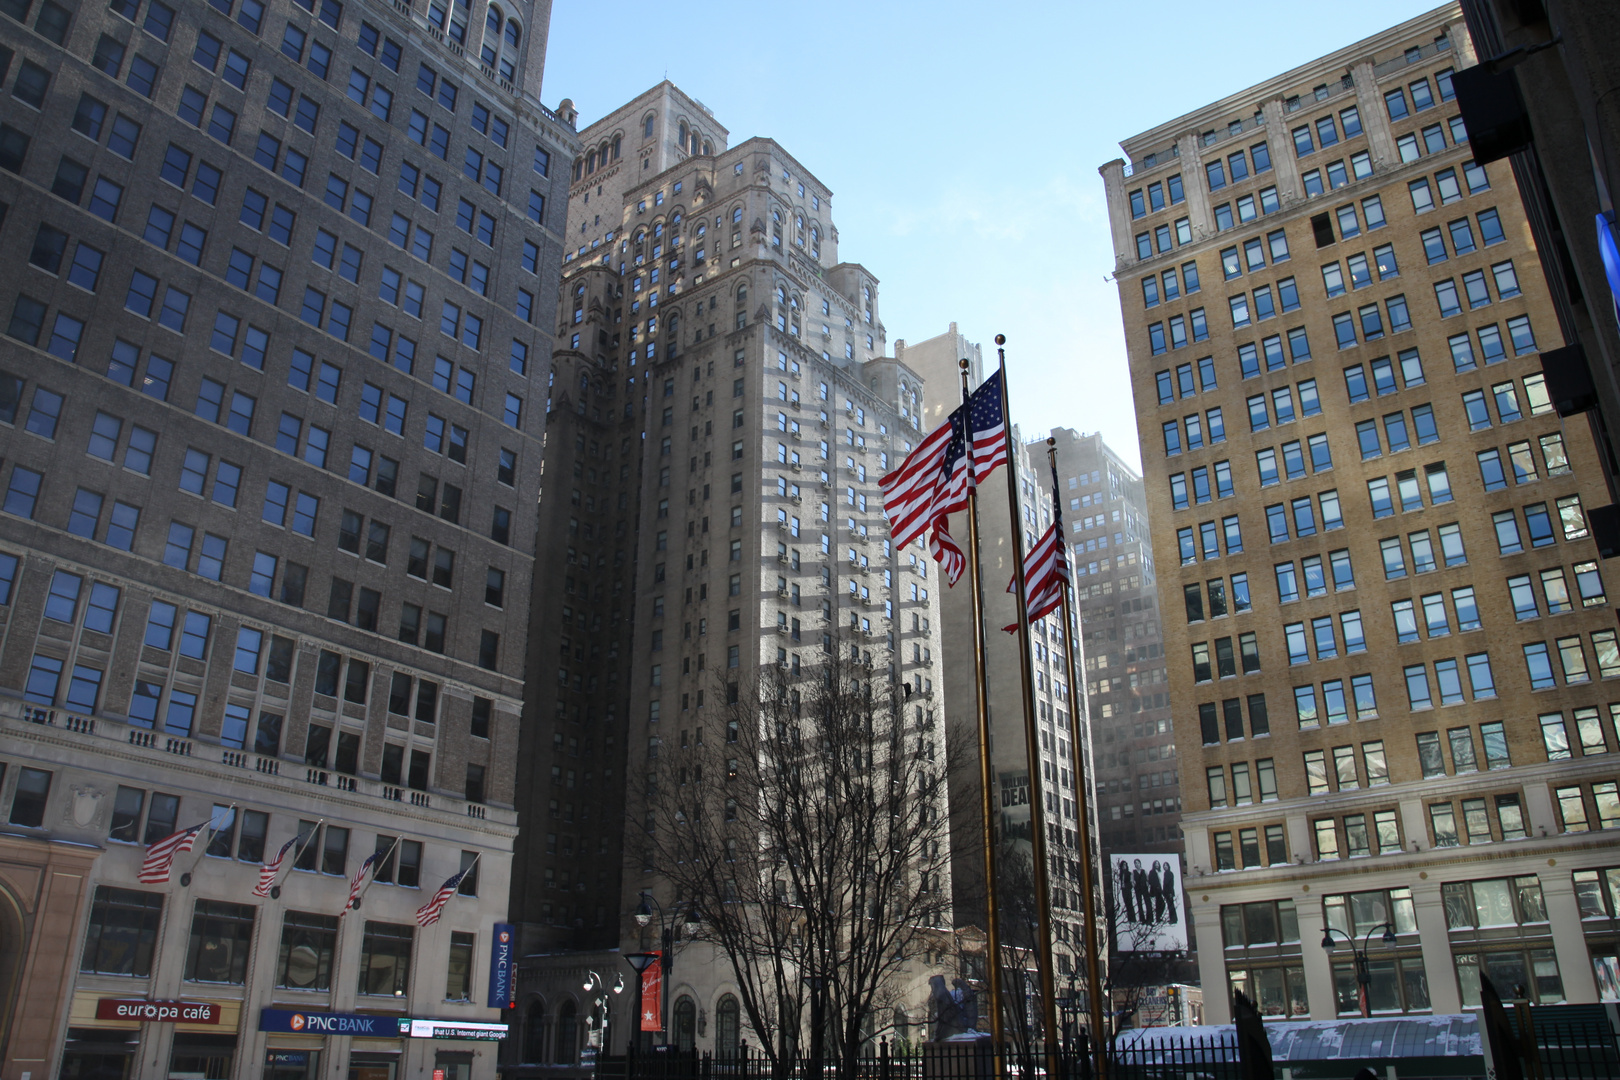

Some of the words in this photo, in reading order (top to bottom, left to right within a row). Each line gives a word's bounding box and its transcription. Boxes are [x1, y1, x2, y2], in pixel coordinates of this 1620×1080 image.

[1000, 775, 1029, 789] WALKIN
[497, 944, 508, 969] PNC
[496, 970, 507, 1001] BANK
[116, 1004, 178, 1021] europa
[183, 1005, 211, 1020] café
[307, 1015, 337, 1031] PNC
[338, 1017, 375, 1033] BANK
[445, 1028, 456, 1036] U.S.
[456, 1029, 476, 1037] Internet
[476, 1030, 489, 1038] giant
[489, 1031, 506, 1039] Google
